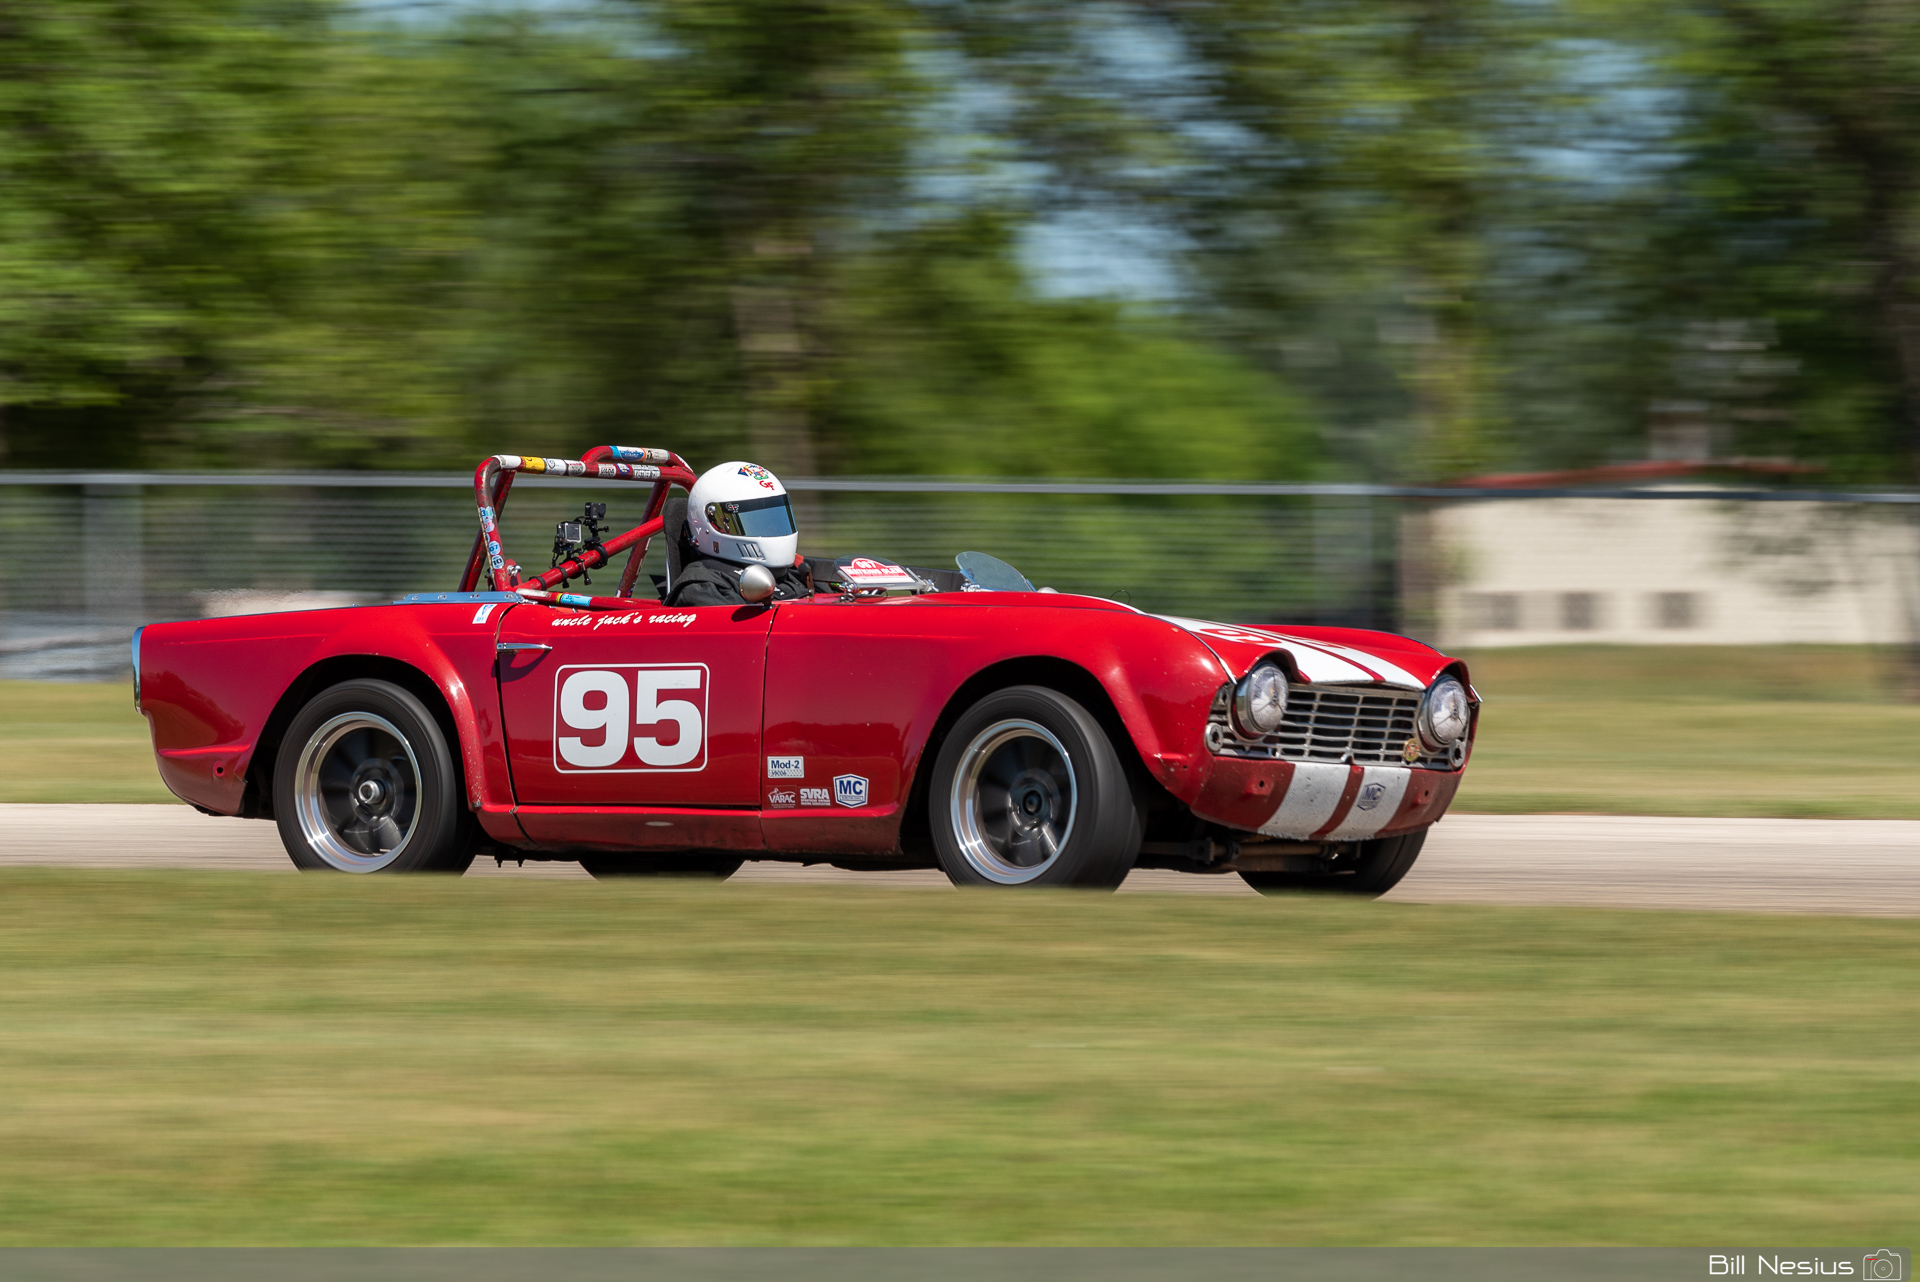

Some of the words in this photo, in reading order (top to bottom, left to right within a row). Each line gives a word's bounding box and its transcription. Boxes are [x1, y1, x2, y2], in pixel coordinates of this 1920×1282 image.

[551, 614, 592, 627] uncle
[593, 612, 643, 631] jack's
[648, 612, 697, 628] racing
[558, 669, 703, 768] 95
[771, 759, 800, 769] Mod-2
[799, 788, 830, 799] SVRA
[839, 780, 863, 795] MC
[768, 793, 796, 804] VARAC
